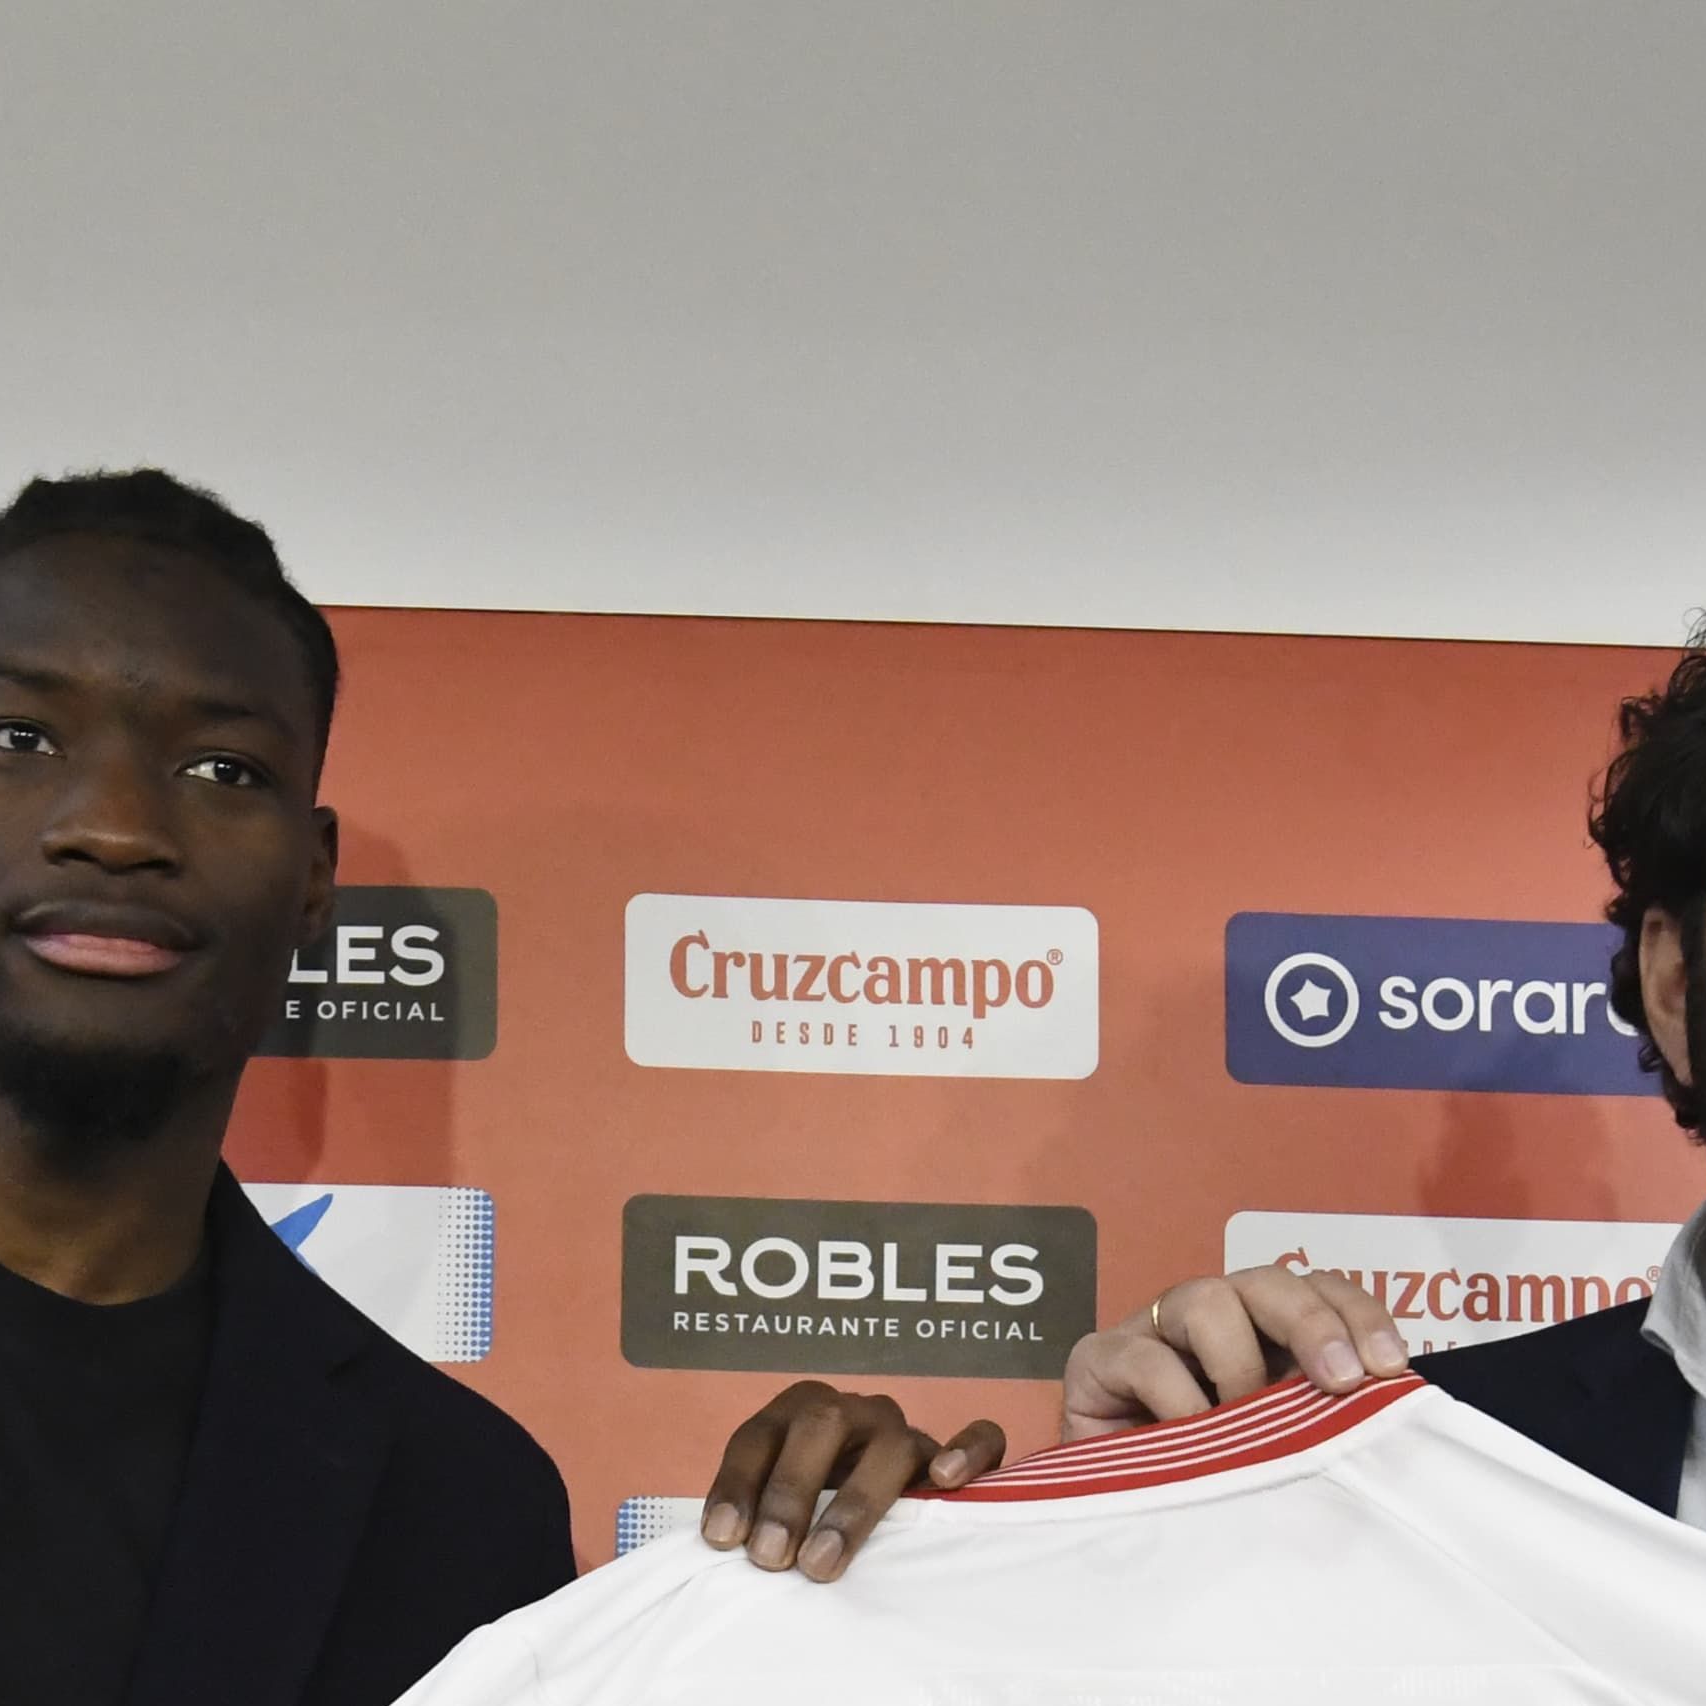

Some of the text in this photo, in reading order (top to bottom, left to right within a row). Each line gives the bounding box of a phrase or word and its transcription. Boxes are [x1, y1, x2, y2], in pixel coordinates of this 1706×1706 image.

[288, 924, 445, 987] LES
[316, 1000, 445, 1022] OFICIAL
[751, 1020, 976, 1050] DESDE 1904
[674, 1235, 1044, 1306] ROBLES
[673, 1311, 1043, 1341] RESTAURANTE OFICIAL
